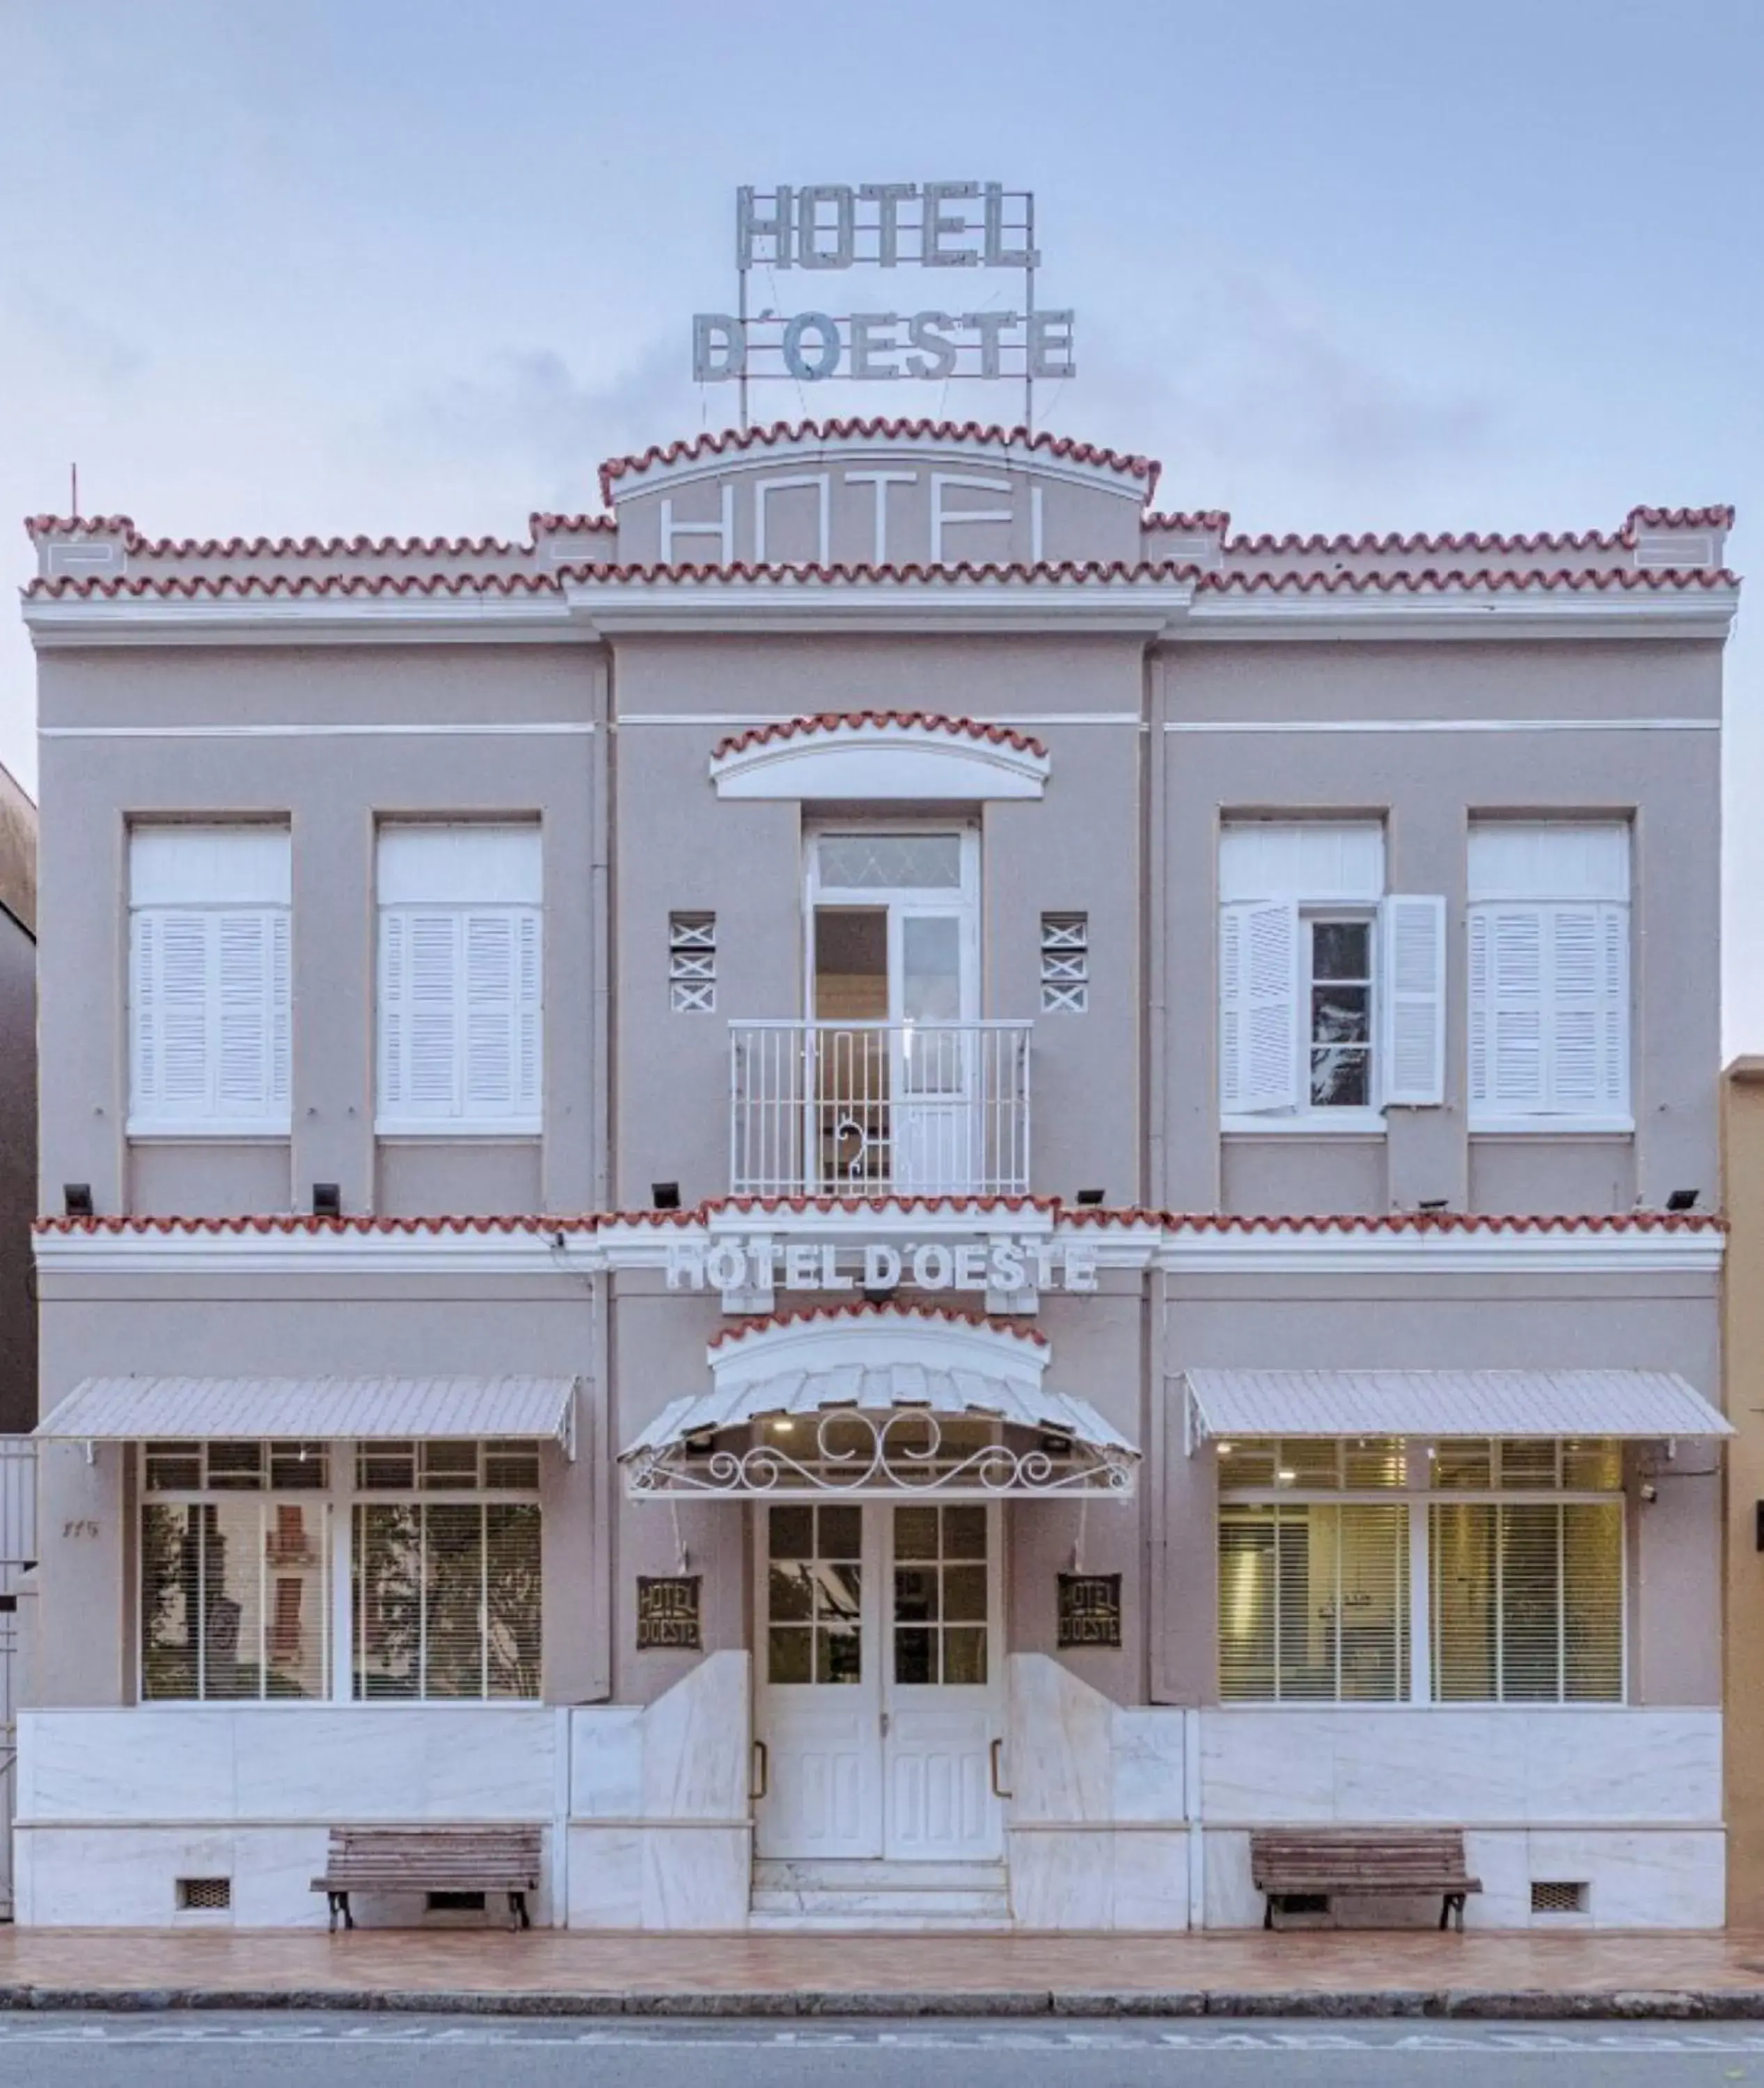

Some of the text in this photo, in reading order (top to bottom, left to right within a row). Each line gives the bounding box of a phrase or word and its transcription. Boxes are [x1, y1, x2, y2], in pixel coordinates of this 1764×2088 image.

[737, 182, 1041, 270] HOTEL
[693, 309, 1076, 382] D'OESTE
[666, 1243, 1098, 1291] HOTEL D'OESTE
[640, 1584, 697, 1615] HOTEL
